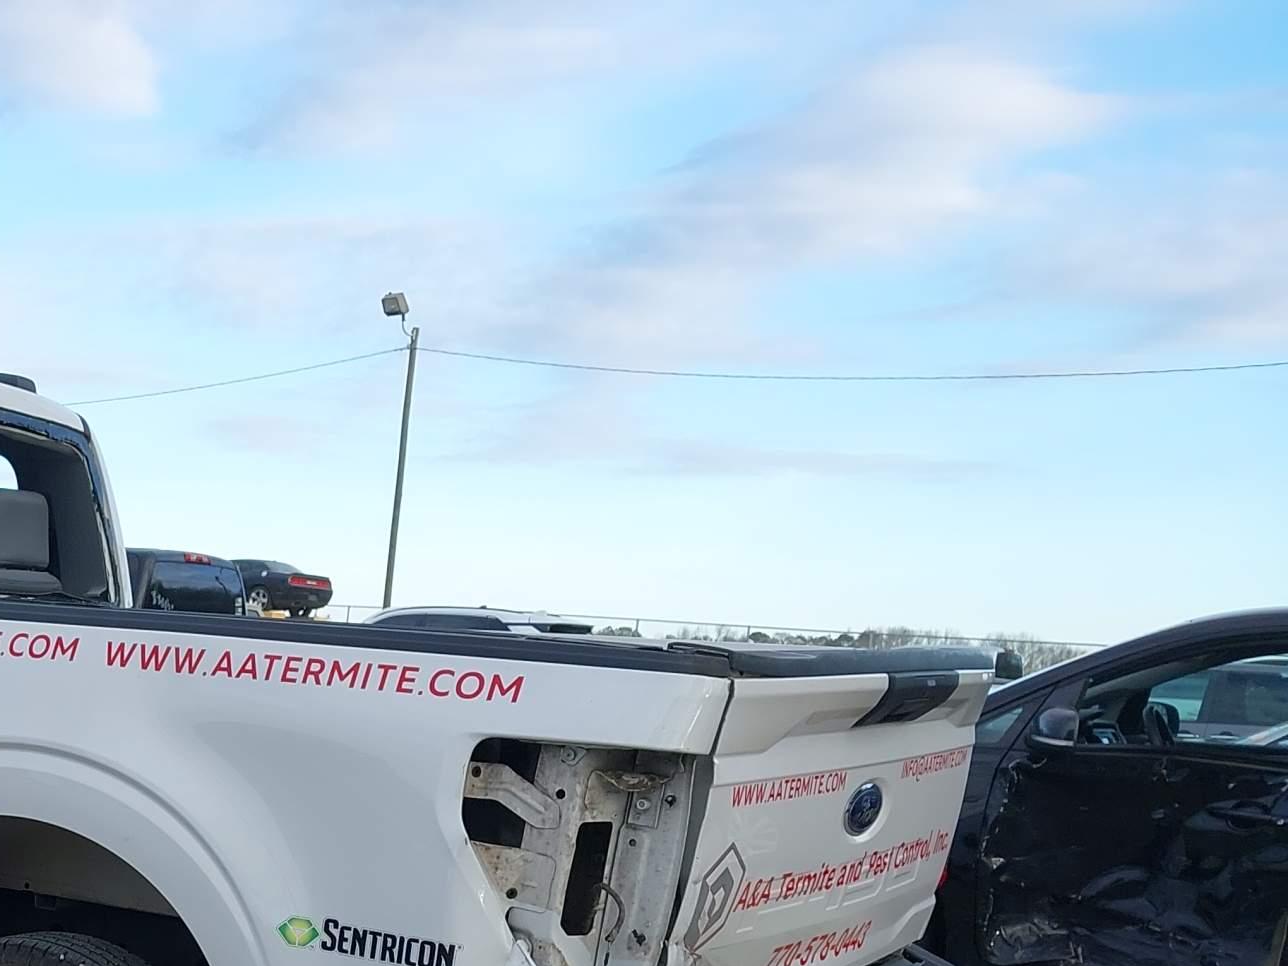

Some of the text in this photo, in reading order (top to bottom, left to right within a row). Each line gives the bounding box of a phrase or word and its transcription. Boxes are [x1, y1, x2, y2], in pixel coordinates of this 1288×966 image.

[106, 640, 524, 704] WWW.AATERMITE.COM
[731, 772, 848, 808] WWW.AATERMITE.COM
[900, 749, 968, 781] INFO@AATERMITE.COM
[733, 829, 949, 912] A&A Termite and Pest Control, Inc.
